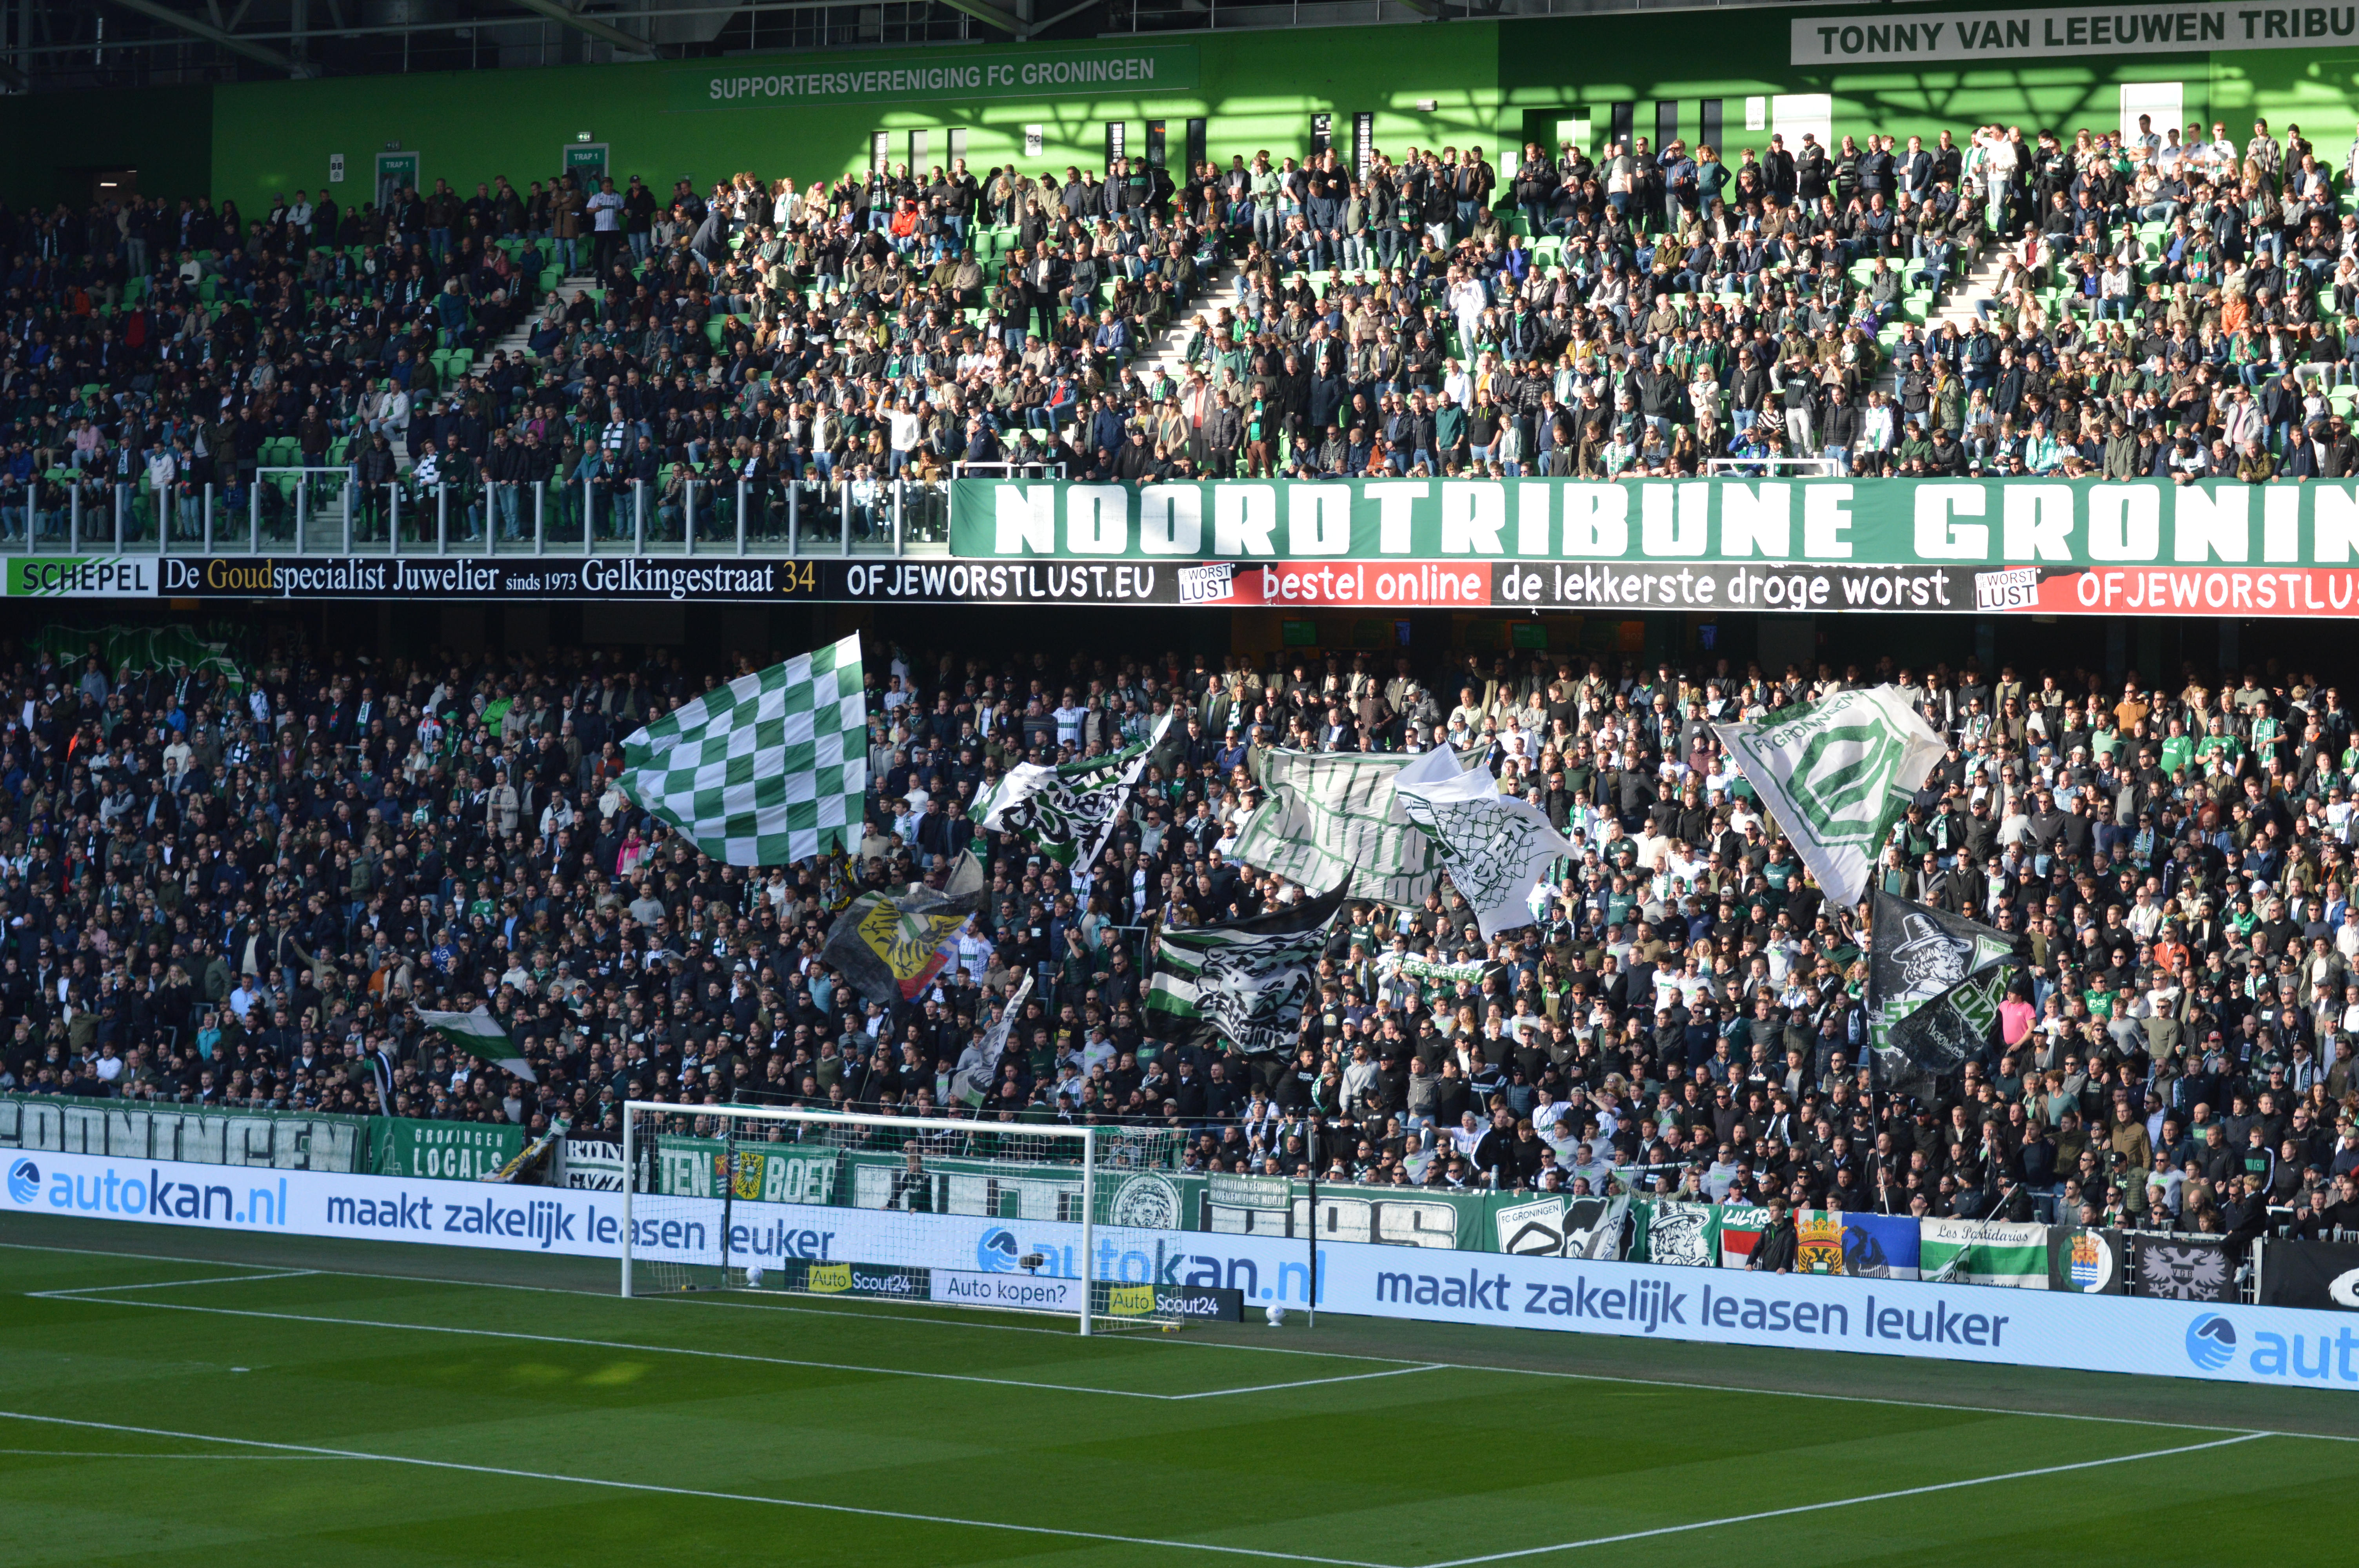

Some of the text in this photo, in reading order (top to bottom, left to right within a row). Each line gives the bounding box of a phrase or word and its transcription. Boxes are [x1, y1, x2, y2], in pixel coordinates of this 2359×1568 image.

[1817, 6, 2355, 55] TONNY VAN LEEUWEN TRIBU
[709, 58, 1155, 99] SUPPORTERSVERENIGING FC GRONINGEN
[995, 481, 1854, 558] NOORDTRIBUNE
[23, 563, 149, 590] SCHEPEL
[165, 558, 815, 599] De Goudspecialist Juwelier sinds 1973 Gelkingestraat 34
[1181, 579, 1231, 601] LUST
[1189, 564, 1230, 580] WORST
[1263, 564, 1950, 610] bestel online de lekkerste droge worst
[1986, 571, 2035, 587] WORST
[2077, 572, 2359, 610] OFJEWORSTLU
[1978, 585, 2033, 608] LUST
[1753, 692, 1854, 754] FC GRONINGEN
[413, 1148, 502, 1178] LOCALS
[659, 1148, 711, 1197] TEN
[49, 1169, 287, 1225] autokan.nl
[327, 1192, 433, 1230] maakt
[444, 1198, 576, 1247] zakelijk
[720, 1214, 835, 1259] leuker
[1243, 1193, 1259, 1204] ONS
[1261, 1194, 1287, 1206] NOOIT
[1501, 1204, 1559, 1224] FC GRONINGEN
[1937, 1224, 1957, 1238] Los
[2173, 1268, 2193, 1278] VGB
[812, 1270, 1219, 1315] Auto Scout24 Auto kopen? Auto Scout24
[1377, 1267, 1510, 1312] maakt
[1525, 1276, 1687, 1332] zakelijk
[1702, 1284, 1848, 1336] leasen
[1865, 1295, 2009, 1347] leuker
